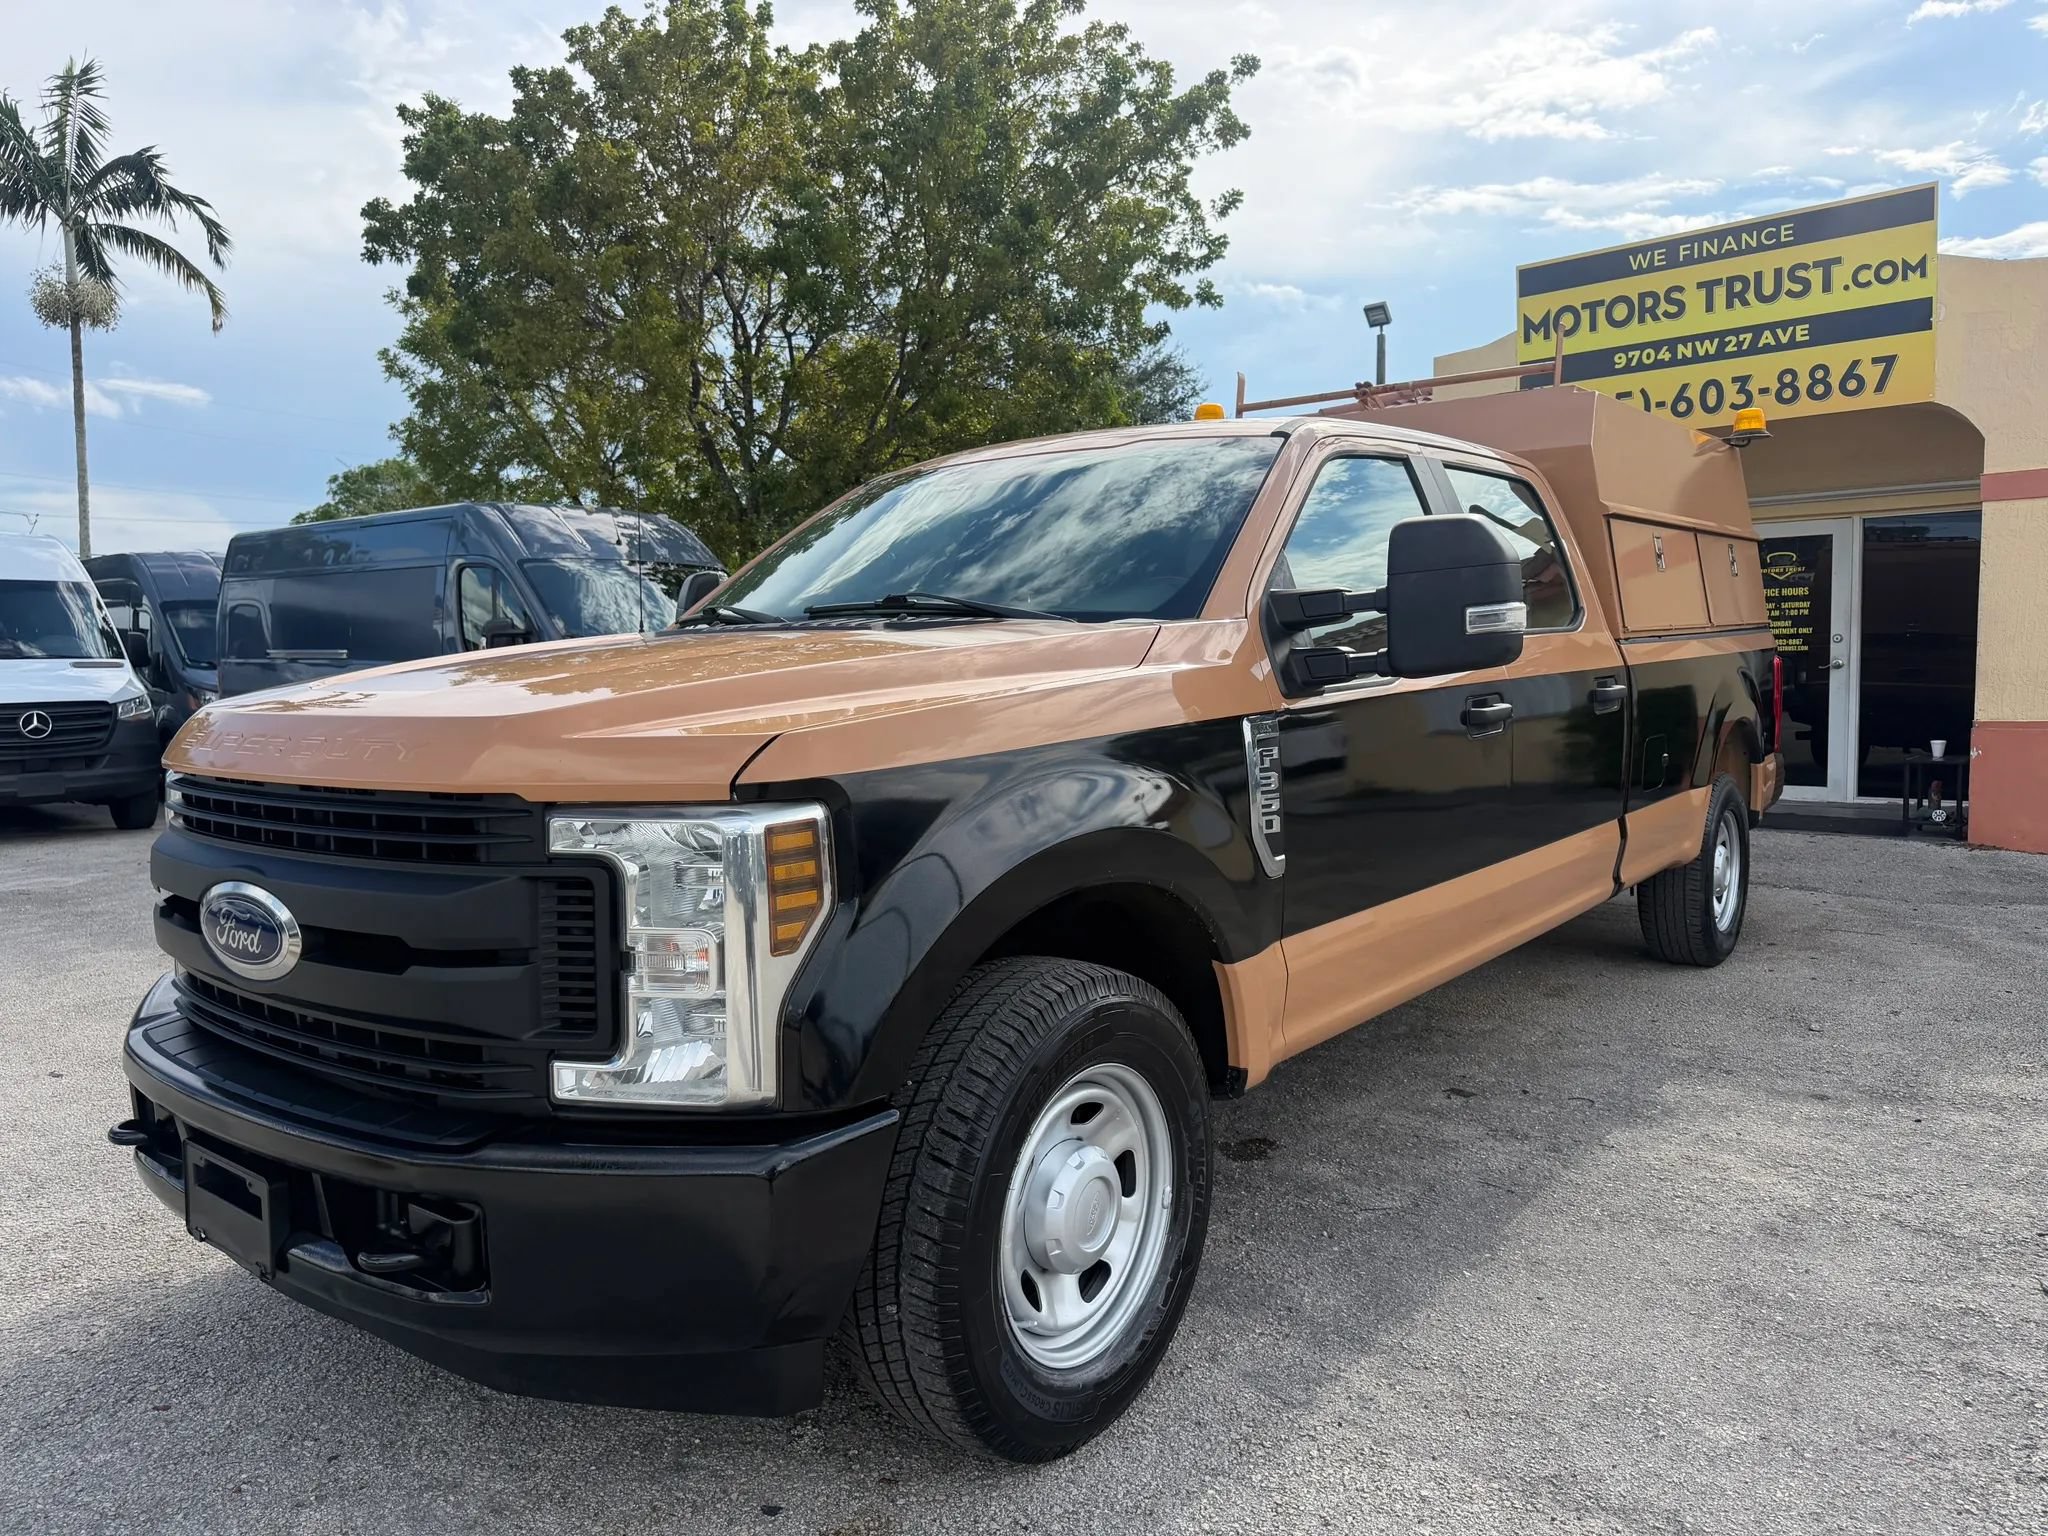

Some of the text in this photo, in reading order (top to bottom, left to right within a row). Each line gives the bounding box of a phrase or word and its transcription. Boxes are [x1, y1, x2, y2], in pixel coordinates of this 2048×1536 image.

[1629, 223, 1795, 271] WE FINANCE
[1523, 253, 1927, 345] MOTORS TRUST.COM
[1614, 323, 1810, 369] 9704 NW 27 AVE
[1781, 587, 1809, 596] HOURS
[1781, 601, 1811, 609] SATURDAY
[216, 907, 262, 953] Ford
